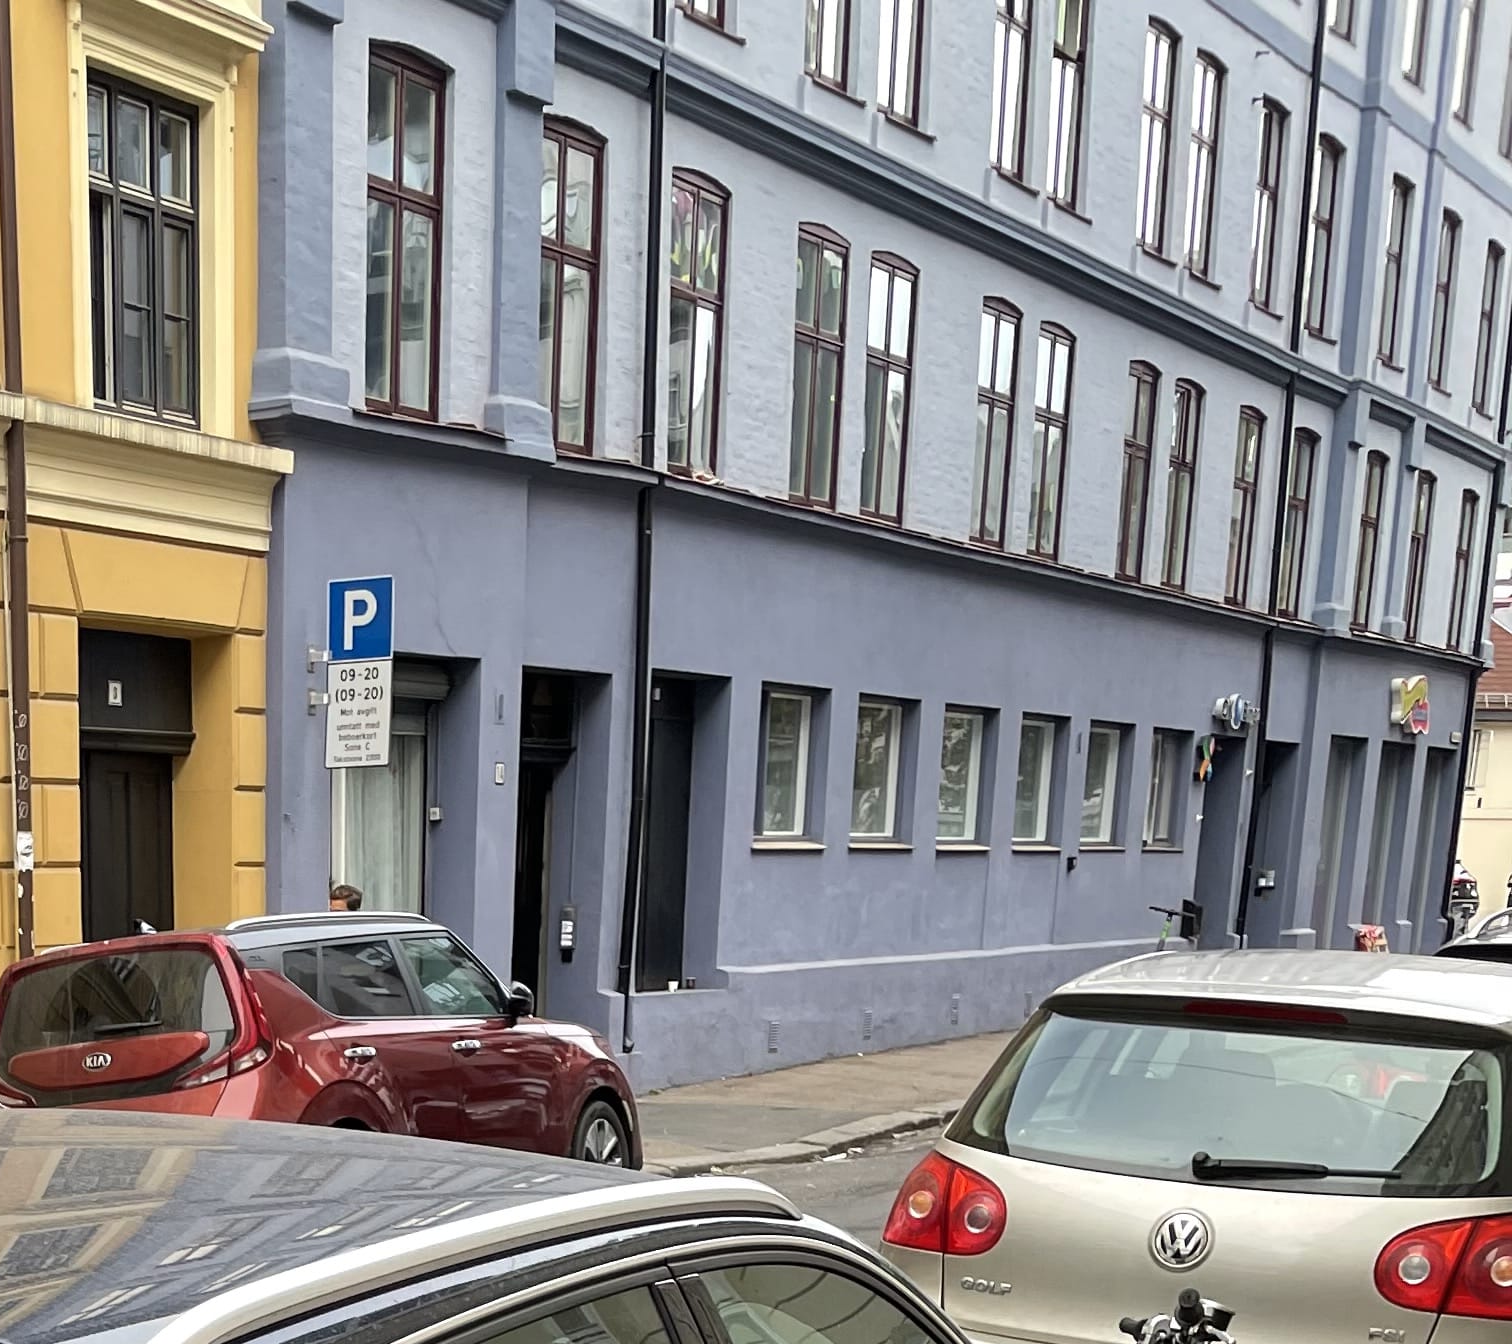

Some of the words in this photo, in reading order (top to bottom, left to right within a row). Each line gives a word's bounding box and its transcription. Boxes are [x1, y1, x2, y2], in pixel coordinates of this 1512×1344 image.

[343, 588, 378, 651] P
[340, 666, 379, 682] 09-20
[335, 685, 384, 703] (09-20)
[84, 1054, 109, 1068] KIA
[960, 1275, 1013, 1297] GOLF
